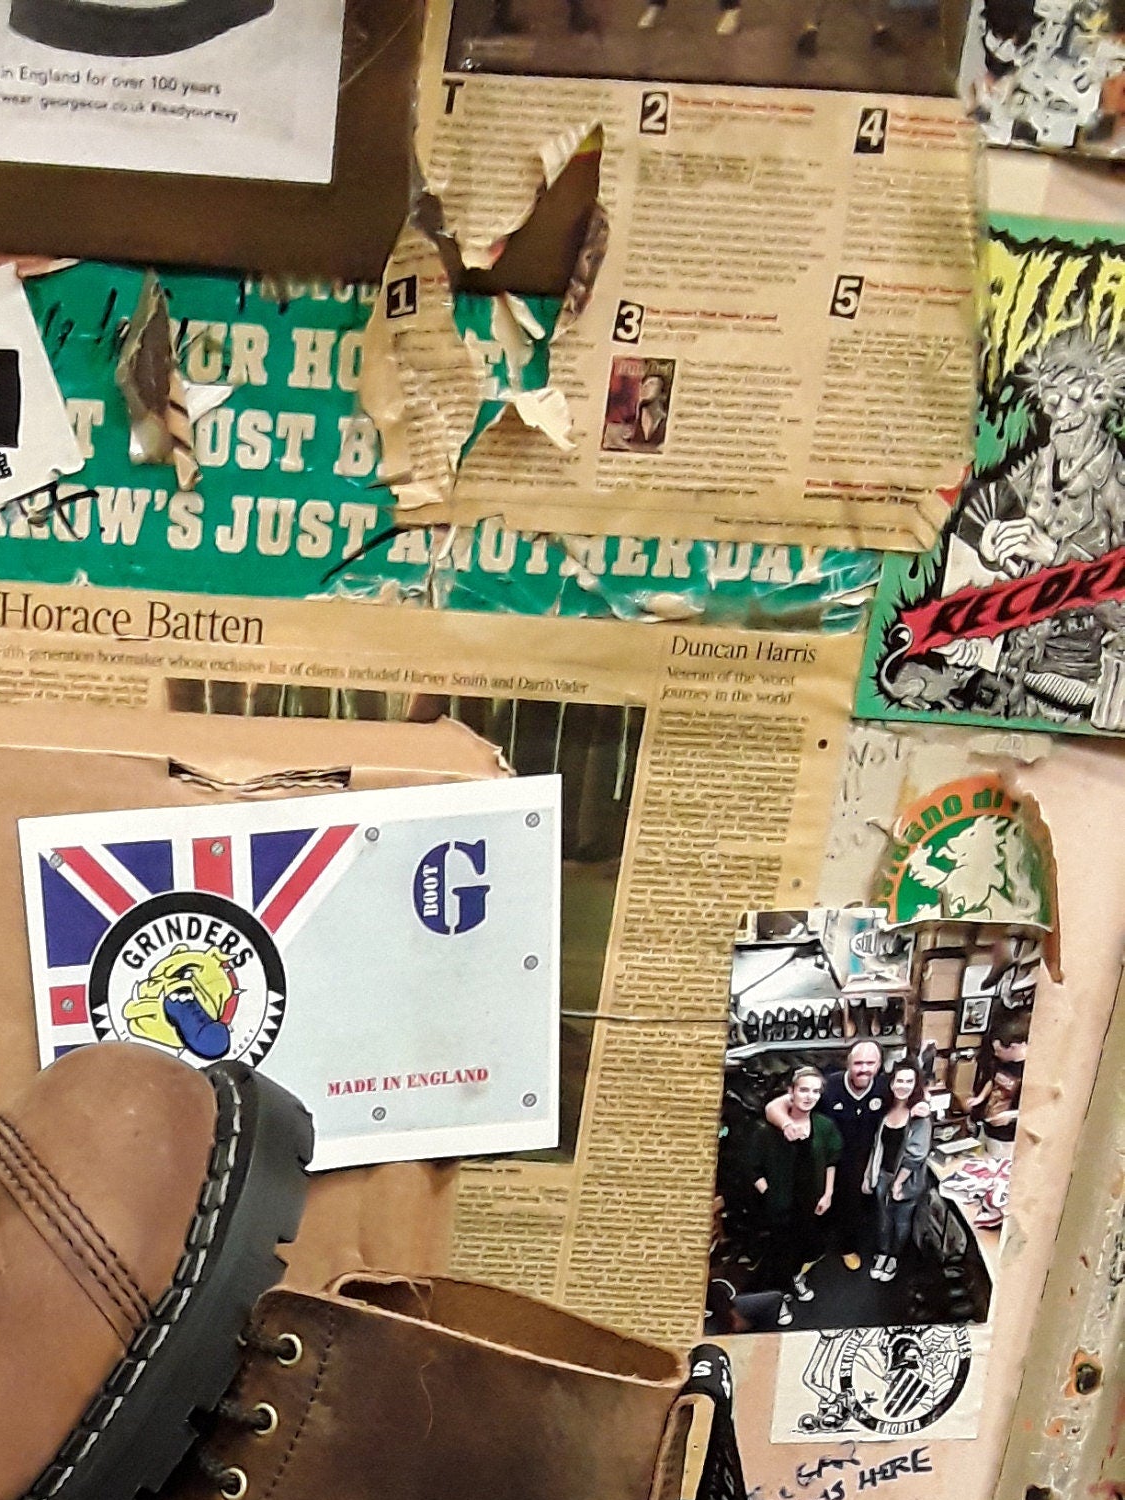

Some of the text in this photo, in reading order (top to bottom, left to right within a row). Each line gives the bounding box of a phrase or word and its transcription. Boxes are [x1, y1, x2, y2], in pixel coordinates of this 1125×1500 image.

[20, 67, 80, 86] England
[86, 70, 107, 86] for
[112, 76, 143, 89] over
[151, 76, 177, 91] 100
[183, 82, 221, 97] years
[642, 94, 666, 132] 2
[859, 110, 885, 148] 4
[389, 282, 413, 318] 1
[834, 279, 859, 314] 5
[616, 305, 642, 338] 3
[171, 320, 270, 386] UR
[193, 408, 313, 472] UST
[215, 499, 377, 560] JUST
[0, 591, 264, 645] Horace Batten
[671, 635, 818, 663] Duncan Harris
[98, 649, 164, 667] bootmaker
[169, 655, 206, 669] whose
[210, 656, 265, 673] exclusive
[268, 660, 287, 674] list
[290, 662, 304, 675] of
[305, 663, 345, 677] clients
[348, 665, 401, 681] included
[404, 669, 445, 687] Harvey
[451, 672, 488, 688] Smith
[491, 674, 513, 689] and
[518, 676, 553, 692] Darth
[555, 678, 590, 694] Vader
[667, 666, 710, 681] Veteran
[717, 669, 733, 683] of
[734, 670, 754, 684] the
[661, 684, 710, 702] journey
[716, 688, 728, 701] in
[732, 689, 752, 702] the
[412, 838, 491, 936] G
[421, 865, 440, 918] BOOT
[122, 916, 254, 971] GRINDERS
[327, 1067, 489, 1097] MADE IN ENGLAND
